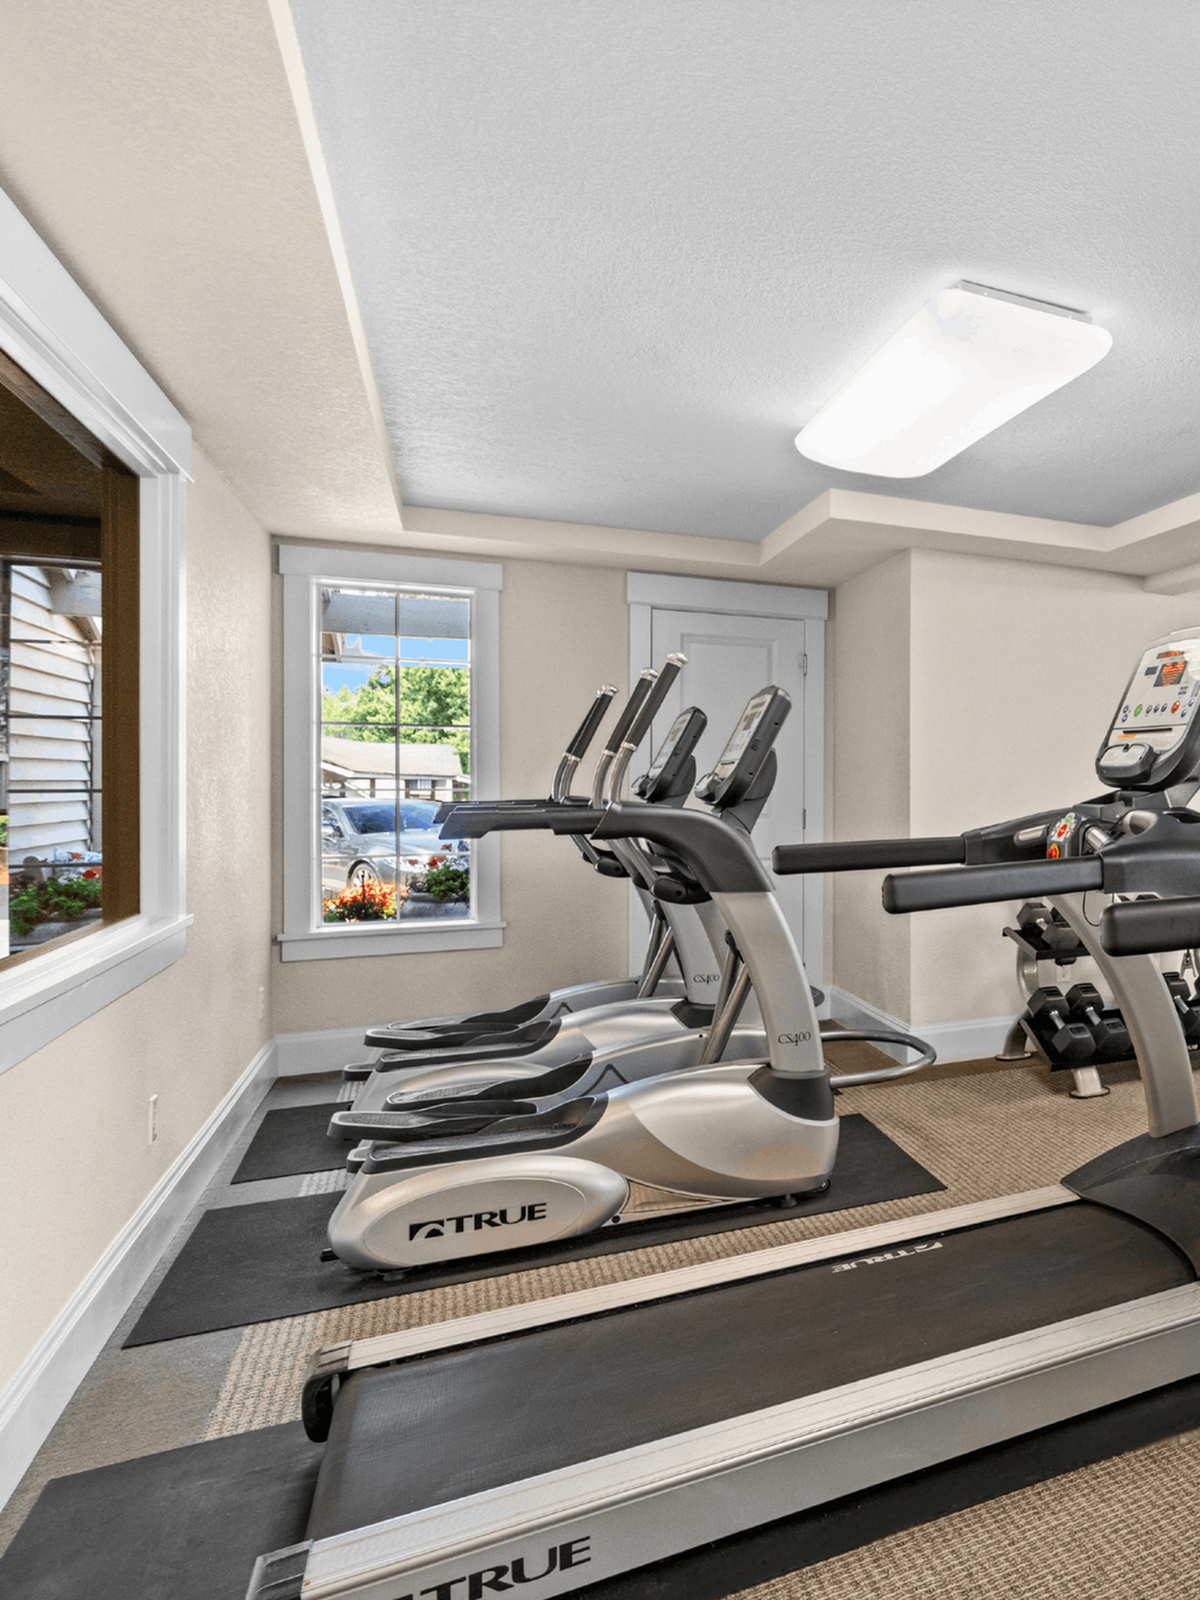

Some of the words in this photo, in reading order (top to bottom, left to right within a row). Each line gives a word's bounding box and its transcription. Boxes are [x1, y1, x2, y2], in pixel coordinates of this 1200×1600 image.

[693, 974, 720, 985] CS400
[777, 1031, 811, 1046] CS400
[446, 1203, 547, 1233] TRUE
[831, 1250, 915, 1273] TRUE
[420, 1535, 591, 1600] TRUE
